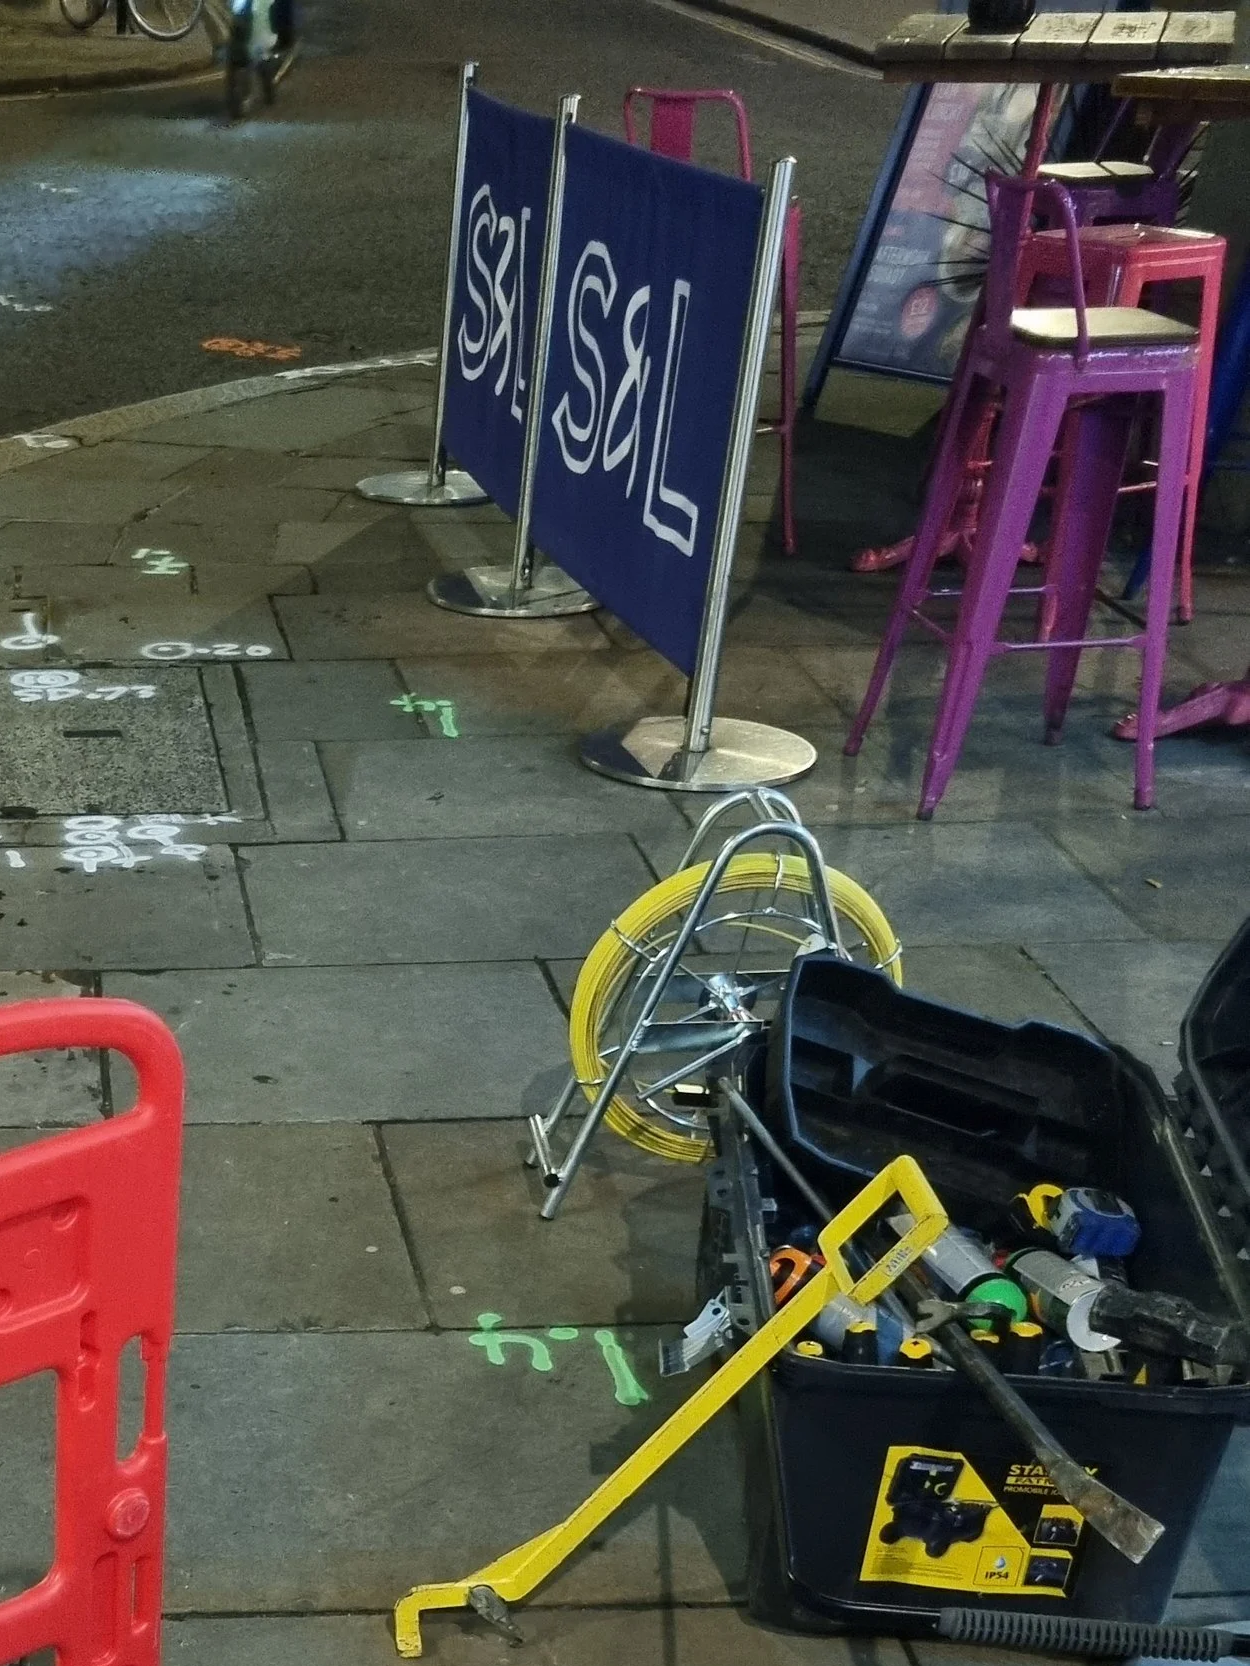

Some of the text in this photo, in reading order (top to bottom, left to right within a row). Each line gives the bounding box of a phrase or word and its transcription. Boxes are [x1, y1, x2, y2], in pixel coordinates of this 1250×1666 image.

[552, 240, 699, 558] S&L
[1009, 1463, 1099, 1477] STAY
[984, 1569, 1010, 1581] IP54
